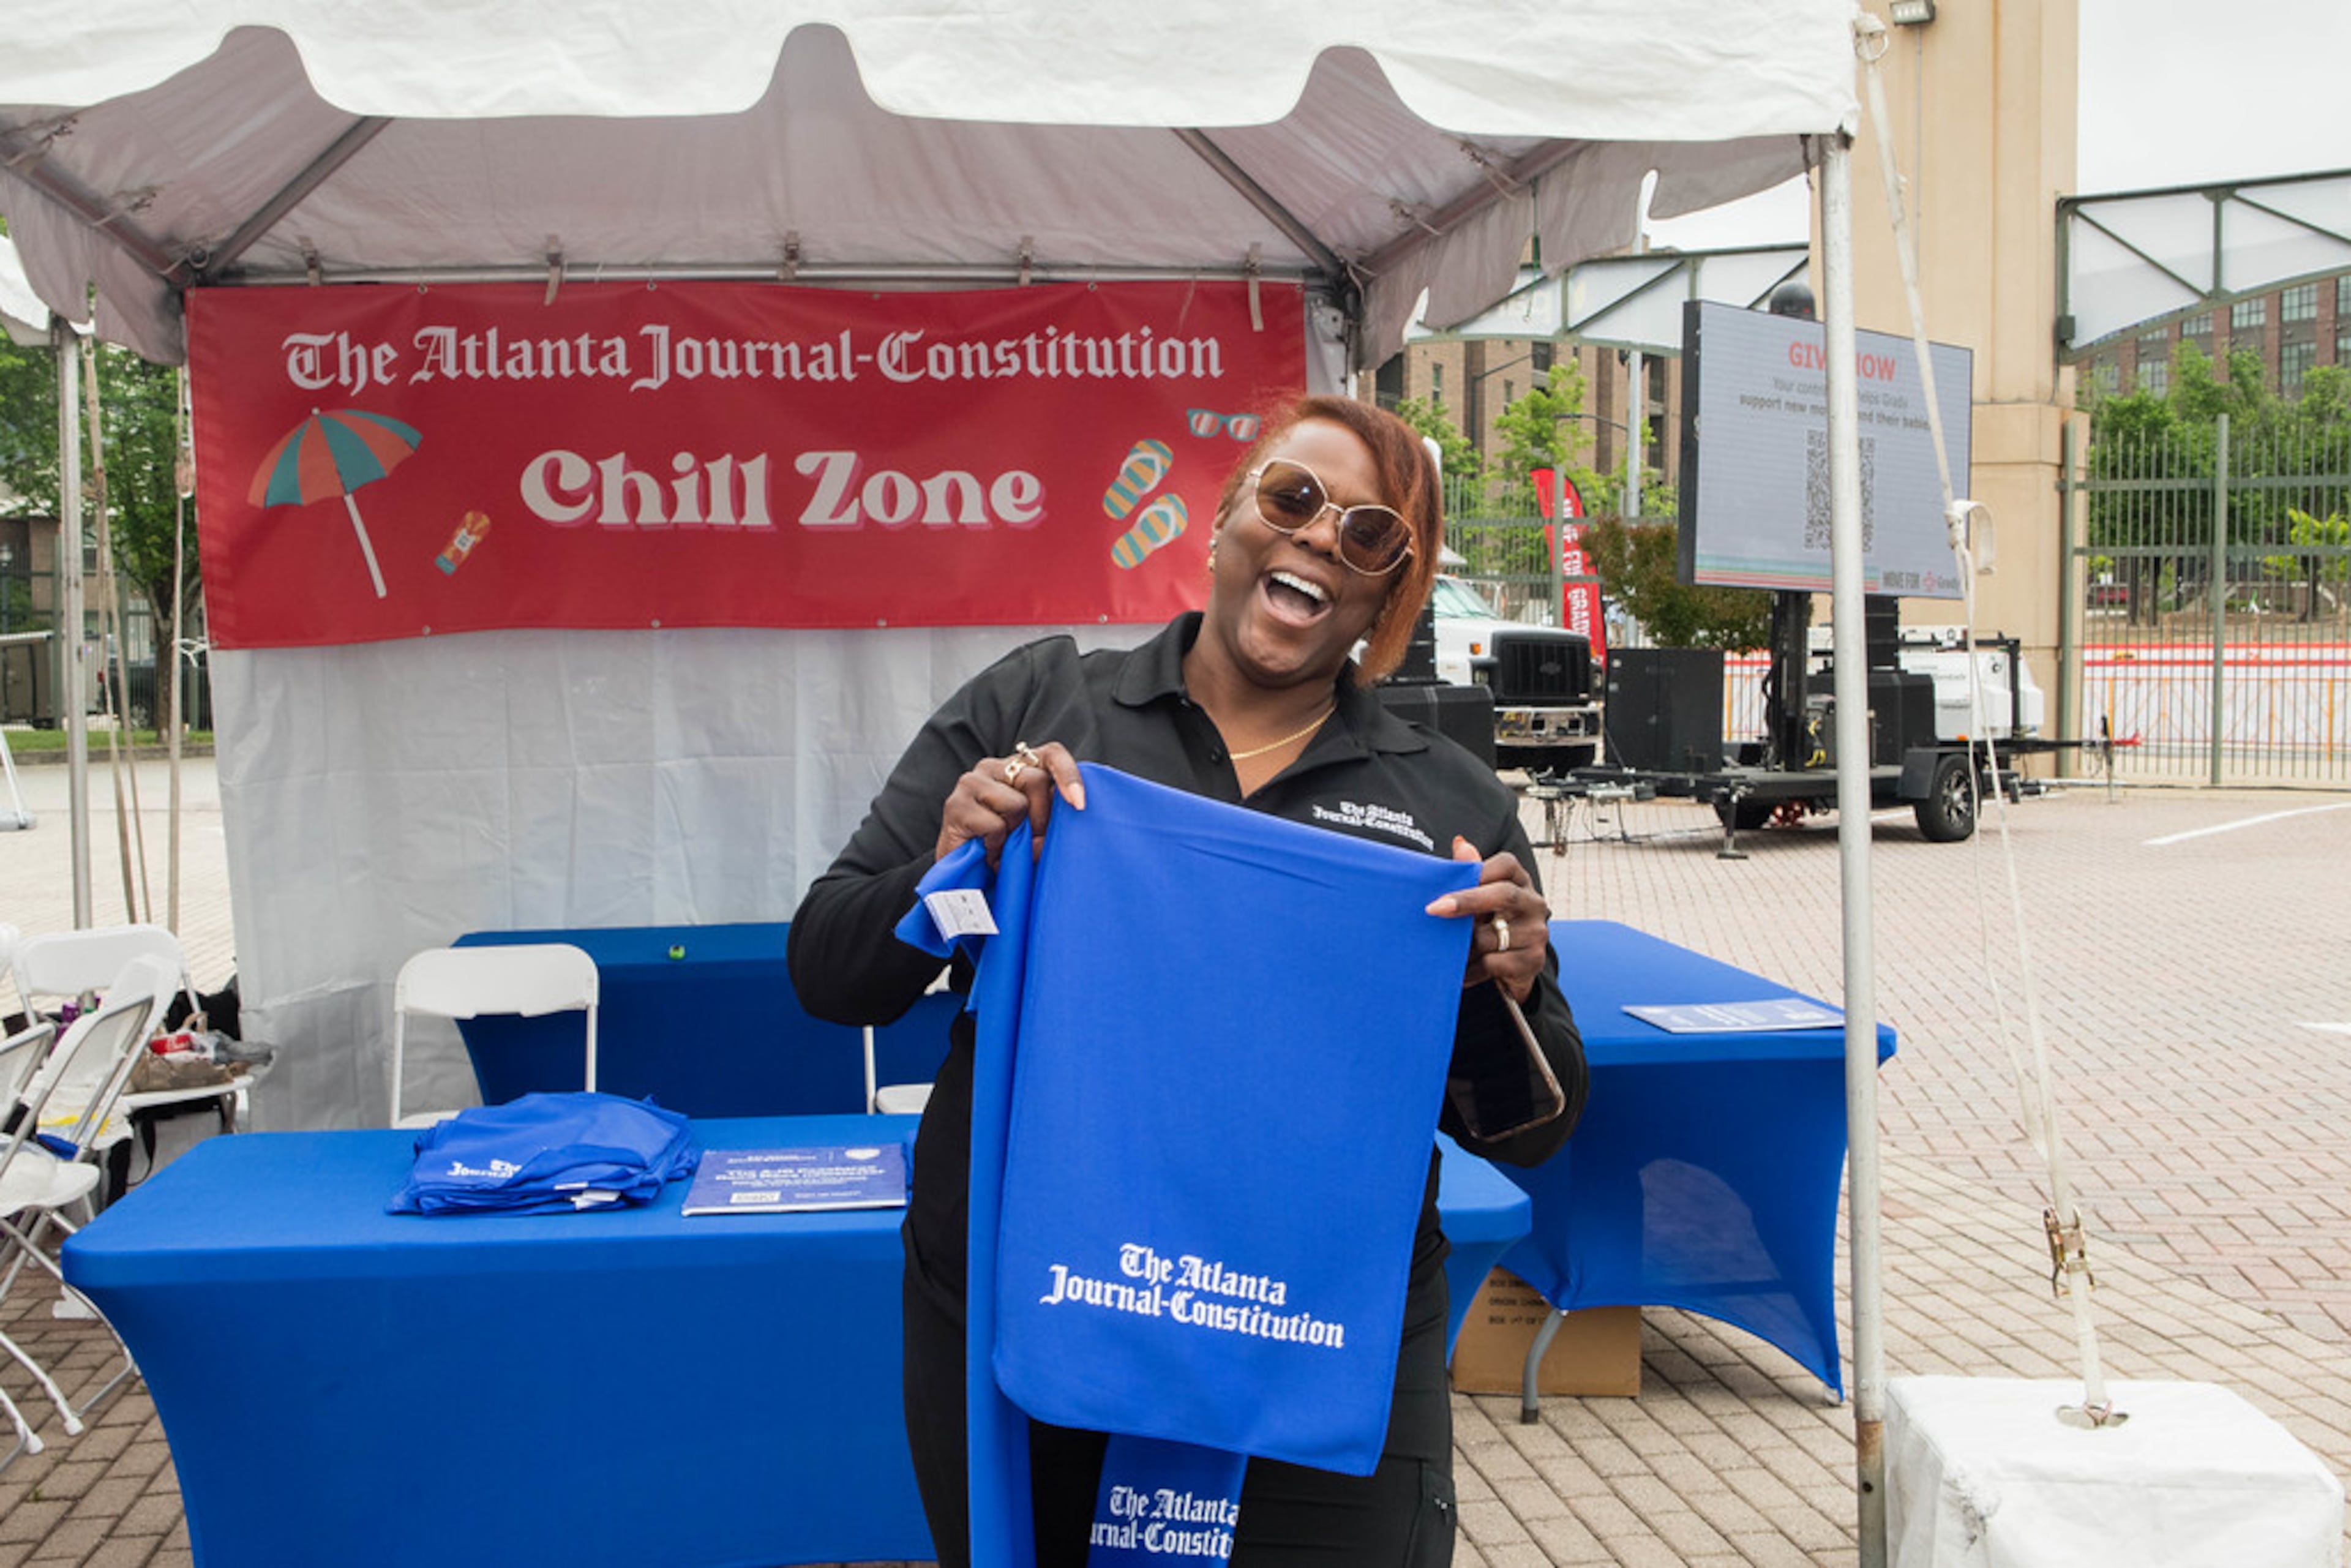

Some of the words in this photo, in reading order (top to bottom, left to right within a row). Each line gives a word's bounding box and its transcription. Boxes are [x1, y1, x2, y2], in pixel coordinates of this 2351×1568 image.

[282, 331, 399, 397] The
[409, 326, 631, 386] Atlanta
[629, 324, 1225, 392] Journal-Constitution
[1789, 342, 1827, 371] GIV
[1740, 394, 1782, 413] support
[1903, 415, 1931, 430] babie
[519, 449, 777, 531] Chill
[794, 450, 1046, 531] Zone
[1340, 800, 1365, 818] The
[1365, 803, 1414, 827] Atlanta
[1119, 1242, 1174, 1286] The
[1174, 1254, 1287, 1307] Atlanta
[1040, 1264, 1346, 1349] Journal-Constitution
[1109, 1484, 1150, 1521] The
[1149, 1488, 1240, 1527] Atlanta
[1089, 1519, 1234, 1559] rnal-Constit
